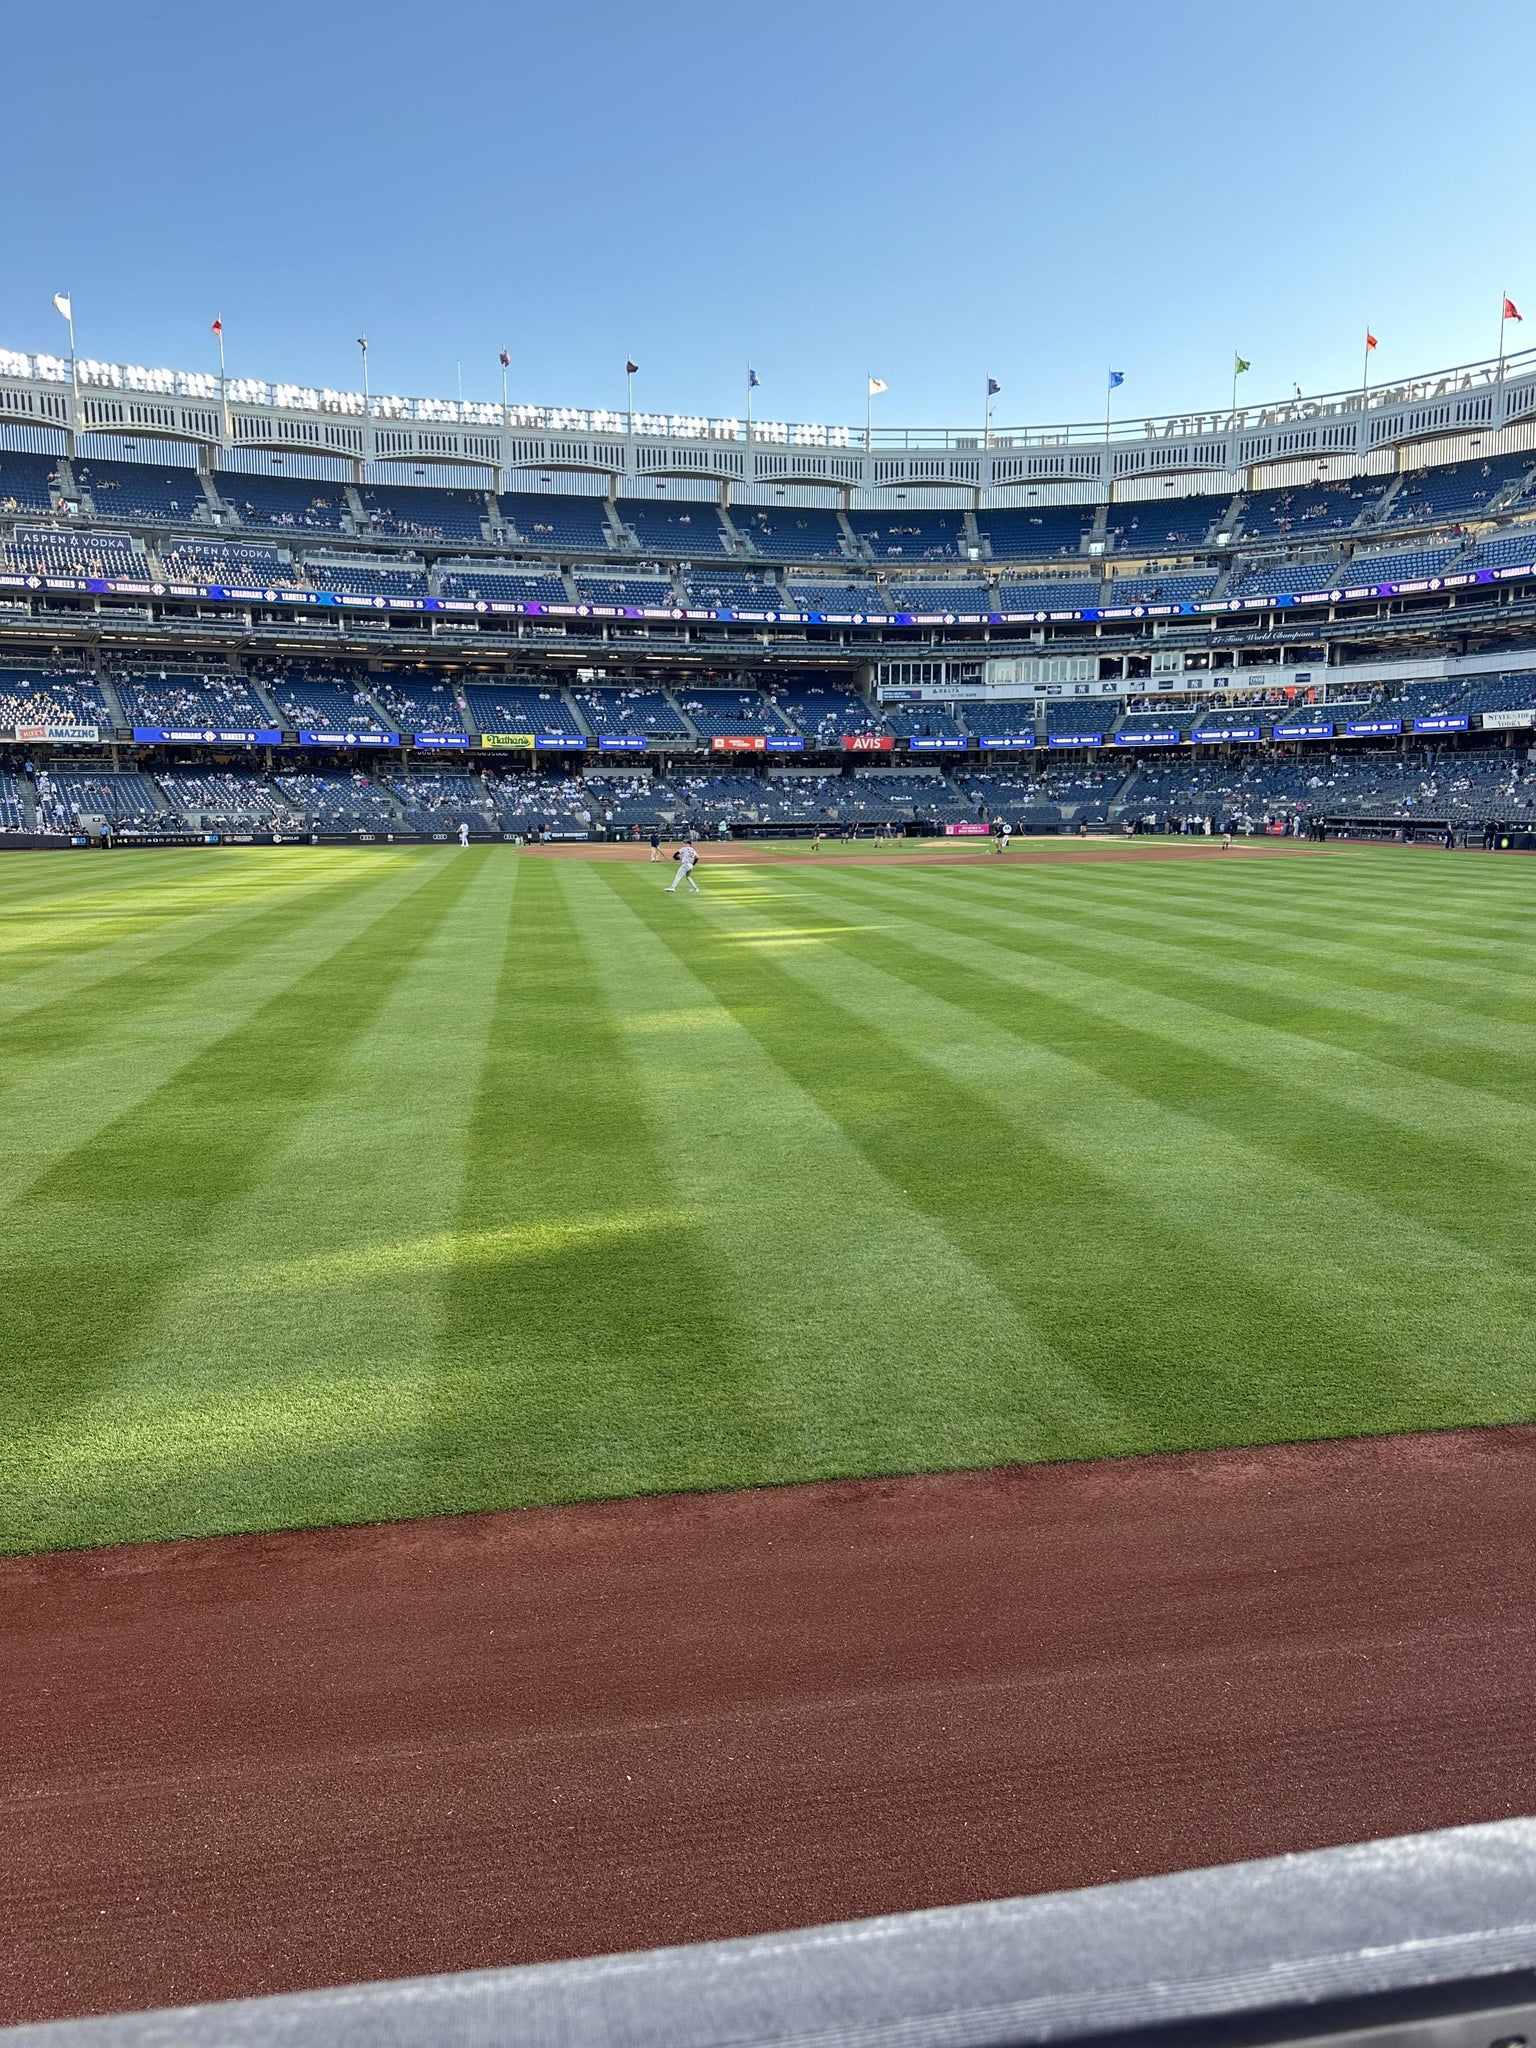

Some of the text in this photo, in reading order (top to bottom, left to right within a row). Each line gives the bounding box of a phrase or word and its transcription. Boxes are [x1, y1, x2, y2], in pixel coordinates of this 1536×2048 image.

[23, 533, 125, 549] ASPEN VODKA
[179, 545, 271, 559] ASPEN VODKA
[45, 579, 76, 589] YANKEES
[116, 583, 150, 593] GUARDIANS
[170, 586, 198, 596] YANKEES
[231, 590, 263, 599] GUARDIANS
[281, 592, 307, 601] YANKEES
[1246, 633, 1271, 641] World
[1272, 631, 1315, 640] Champions
[48, 729, 95, 738] AMAZING
[220, 732, 245, 740] YANKEES
[487, 734, 530, 745] Nathan's
[853, 738, 881, 749] AVIS
